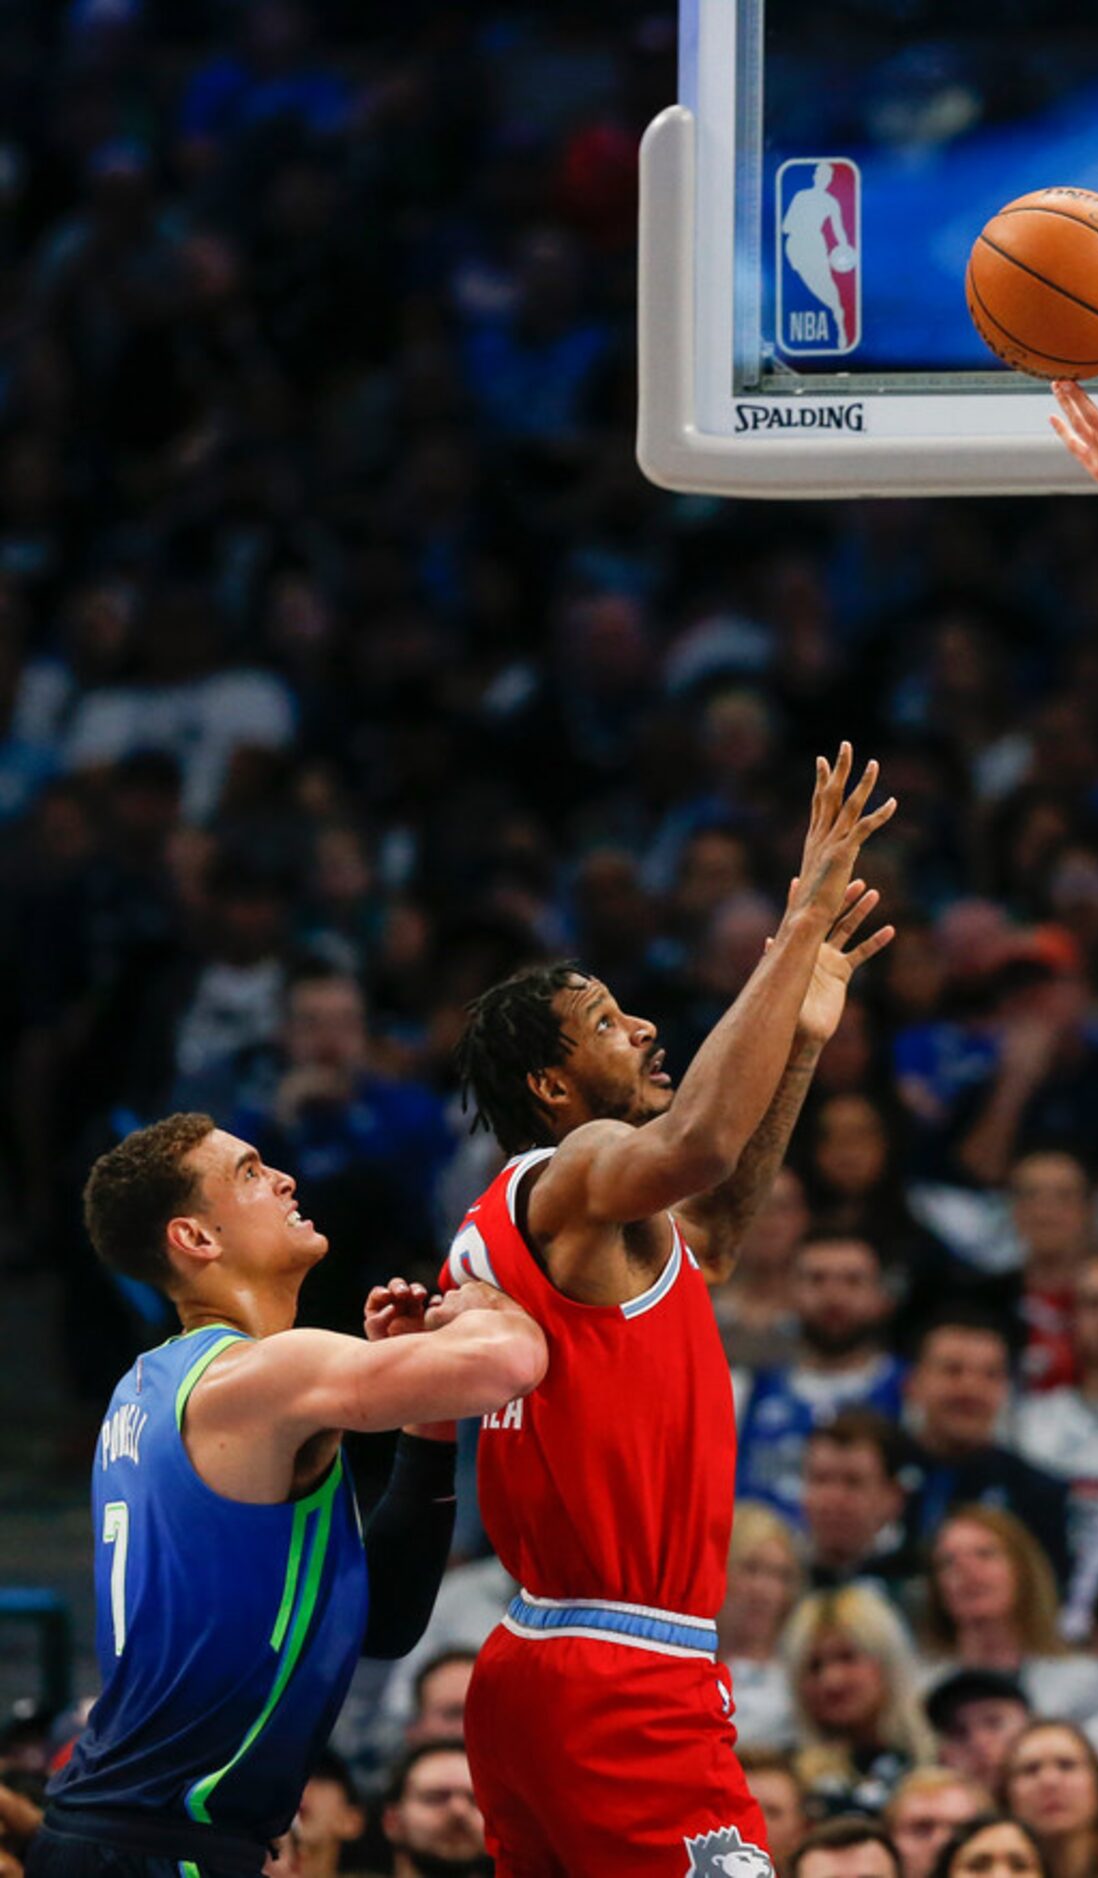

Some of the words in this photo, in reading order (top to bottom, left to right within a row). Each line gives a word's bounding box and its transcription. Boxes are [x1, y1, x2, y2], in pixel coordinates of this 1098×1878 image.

[789, 310, 829, 342] NBA
[734, 402, 864, 433] SPALDING
[102, 1501, 130, 1657] 7
